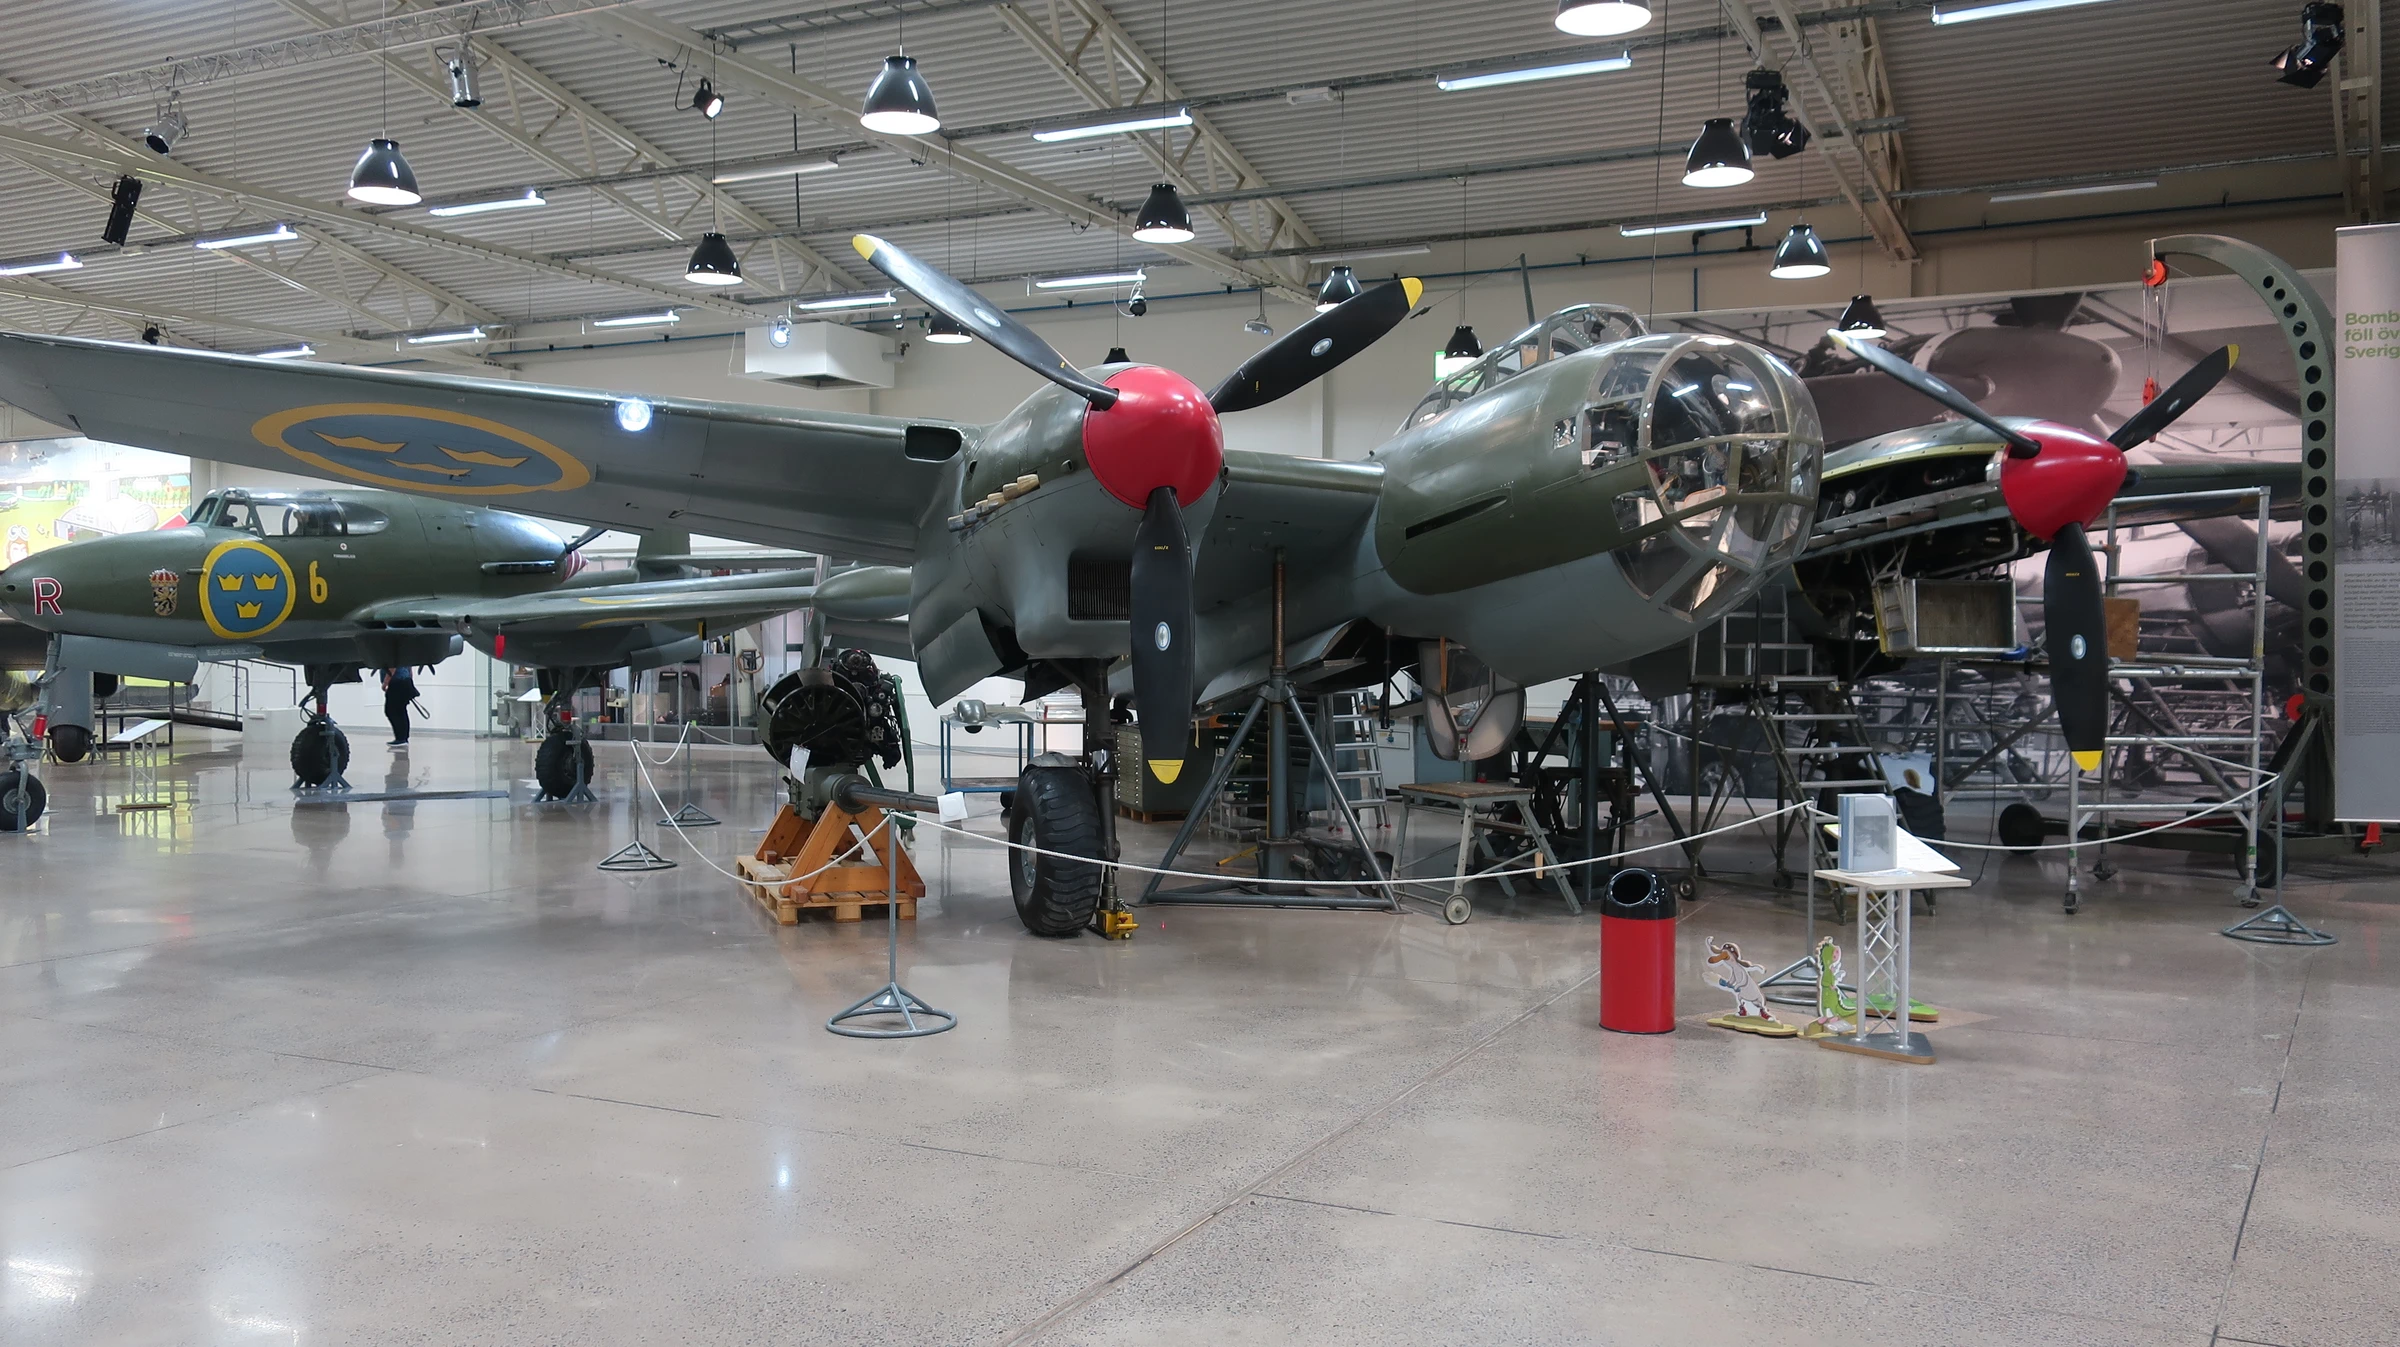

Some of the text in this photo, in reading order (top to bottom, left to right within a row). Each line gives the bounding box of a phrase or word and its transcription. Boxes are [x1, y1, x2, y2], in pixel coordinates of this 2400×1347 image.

[2345, 312, 2400, 325] Bomb
[2344, 328, 2373, 342] föll
[2344, 343, 2400, 359] Sverig
[309, 560, 328, 604] 6
[32, 576, 63, 616] R
